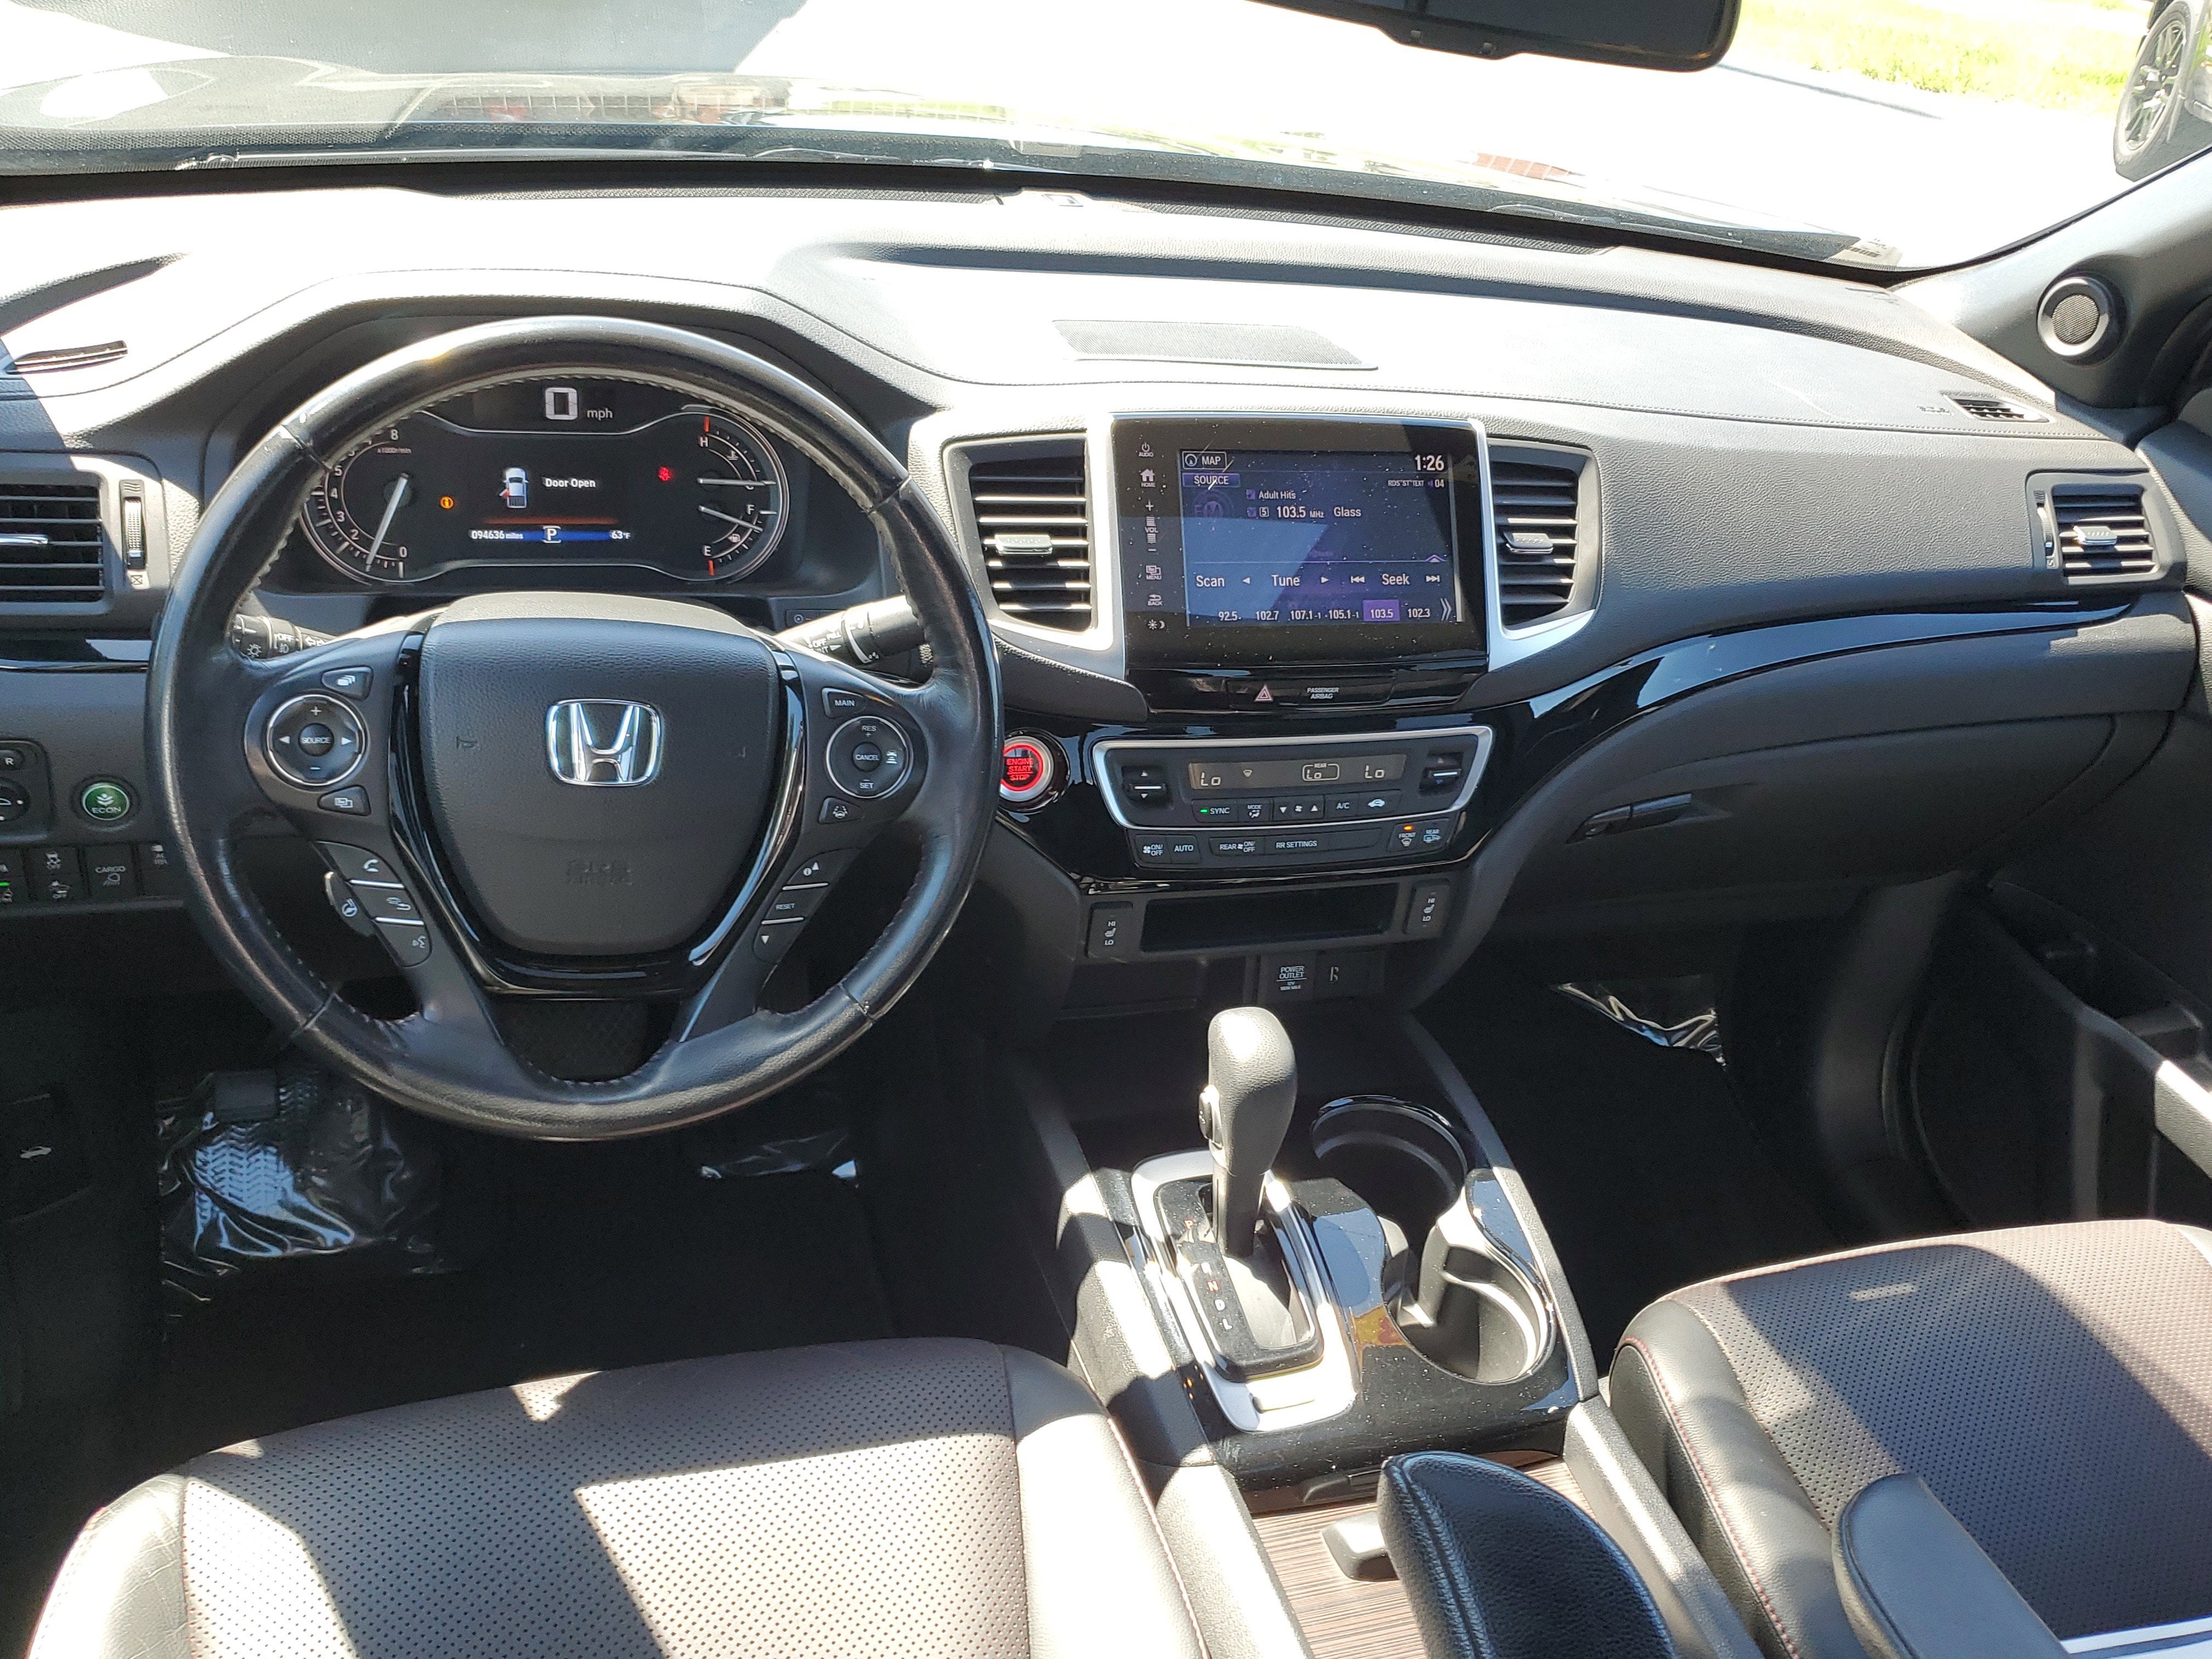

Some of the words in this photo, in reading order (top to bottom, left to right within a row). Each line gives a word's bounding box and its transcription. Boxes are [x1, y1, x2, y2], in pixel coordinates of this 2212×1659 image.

[545, 387, 578, 420] 0
[587, 408, 613, 420] mph
[390, 429, 399, 440] 8
[699, 437, 709, 447] H
[1201, 456, 1221, 465] MAP
[1415, 455, 1444, 471] 1:26
[334, 466, 342, 476] 5
[545, 478, 568, 487] Door
[571, 478, 596, 488] Open
[1194, 475, 1229, 485] SOURCE
[1435, 479, 1444, 488] 04
[330, 488, 338, 499] 4
[1259, 490, 1279, 499] Adult
[1280, 489, 1296, 499] Hits
[747, 504, 755, 515] F
[1261, 507, 1267, 516] 5
[1277, 506, 1306, 518] 103.5
[1334, 506, 1362, 517] Glass
[336, 511, 345, 522] 3
[351, 529, 359, 540] 2
[471, 530, 505, 540] 094636
[548, 528, 557, 541] P
[399, 546, 408, 557] 0
[704, 545, 712, 556] E
[1196, 575, 1225, 587] Scan
[1271, 574, 1300, 586] Tune
[1381, 573, 1410, 585] Seek
[1218, 611, 1238, 621] 92.5
[1256, 611, 1279, 621] 102.7
[1370, 609, 1393, 618] 103.5
[1408, 608, 1431, 618] 102.3
[1336, 802, 1350, 810] A/C
[1286, 840, 1317, 848] SETTINGS
[1184, 1220, 1194, 1229] P
[1208, 1281, 1218, 1291] N
[1215, 1299, 1225, 1311] D
[1222, 1318, 1232, 1330] L
